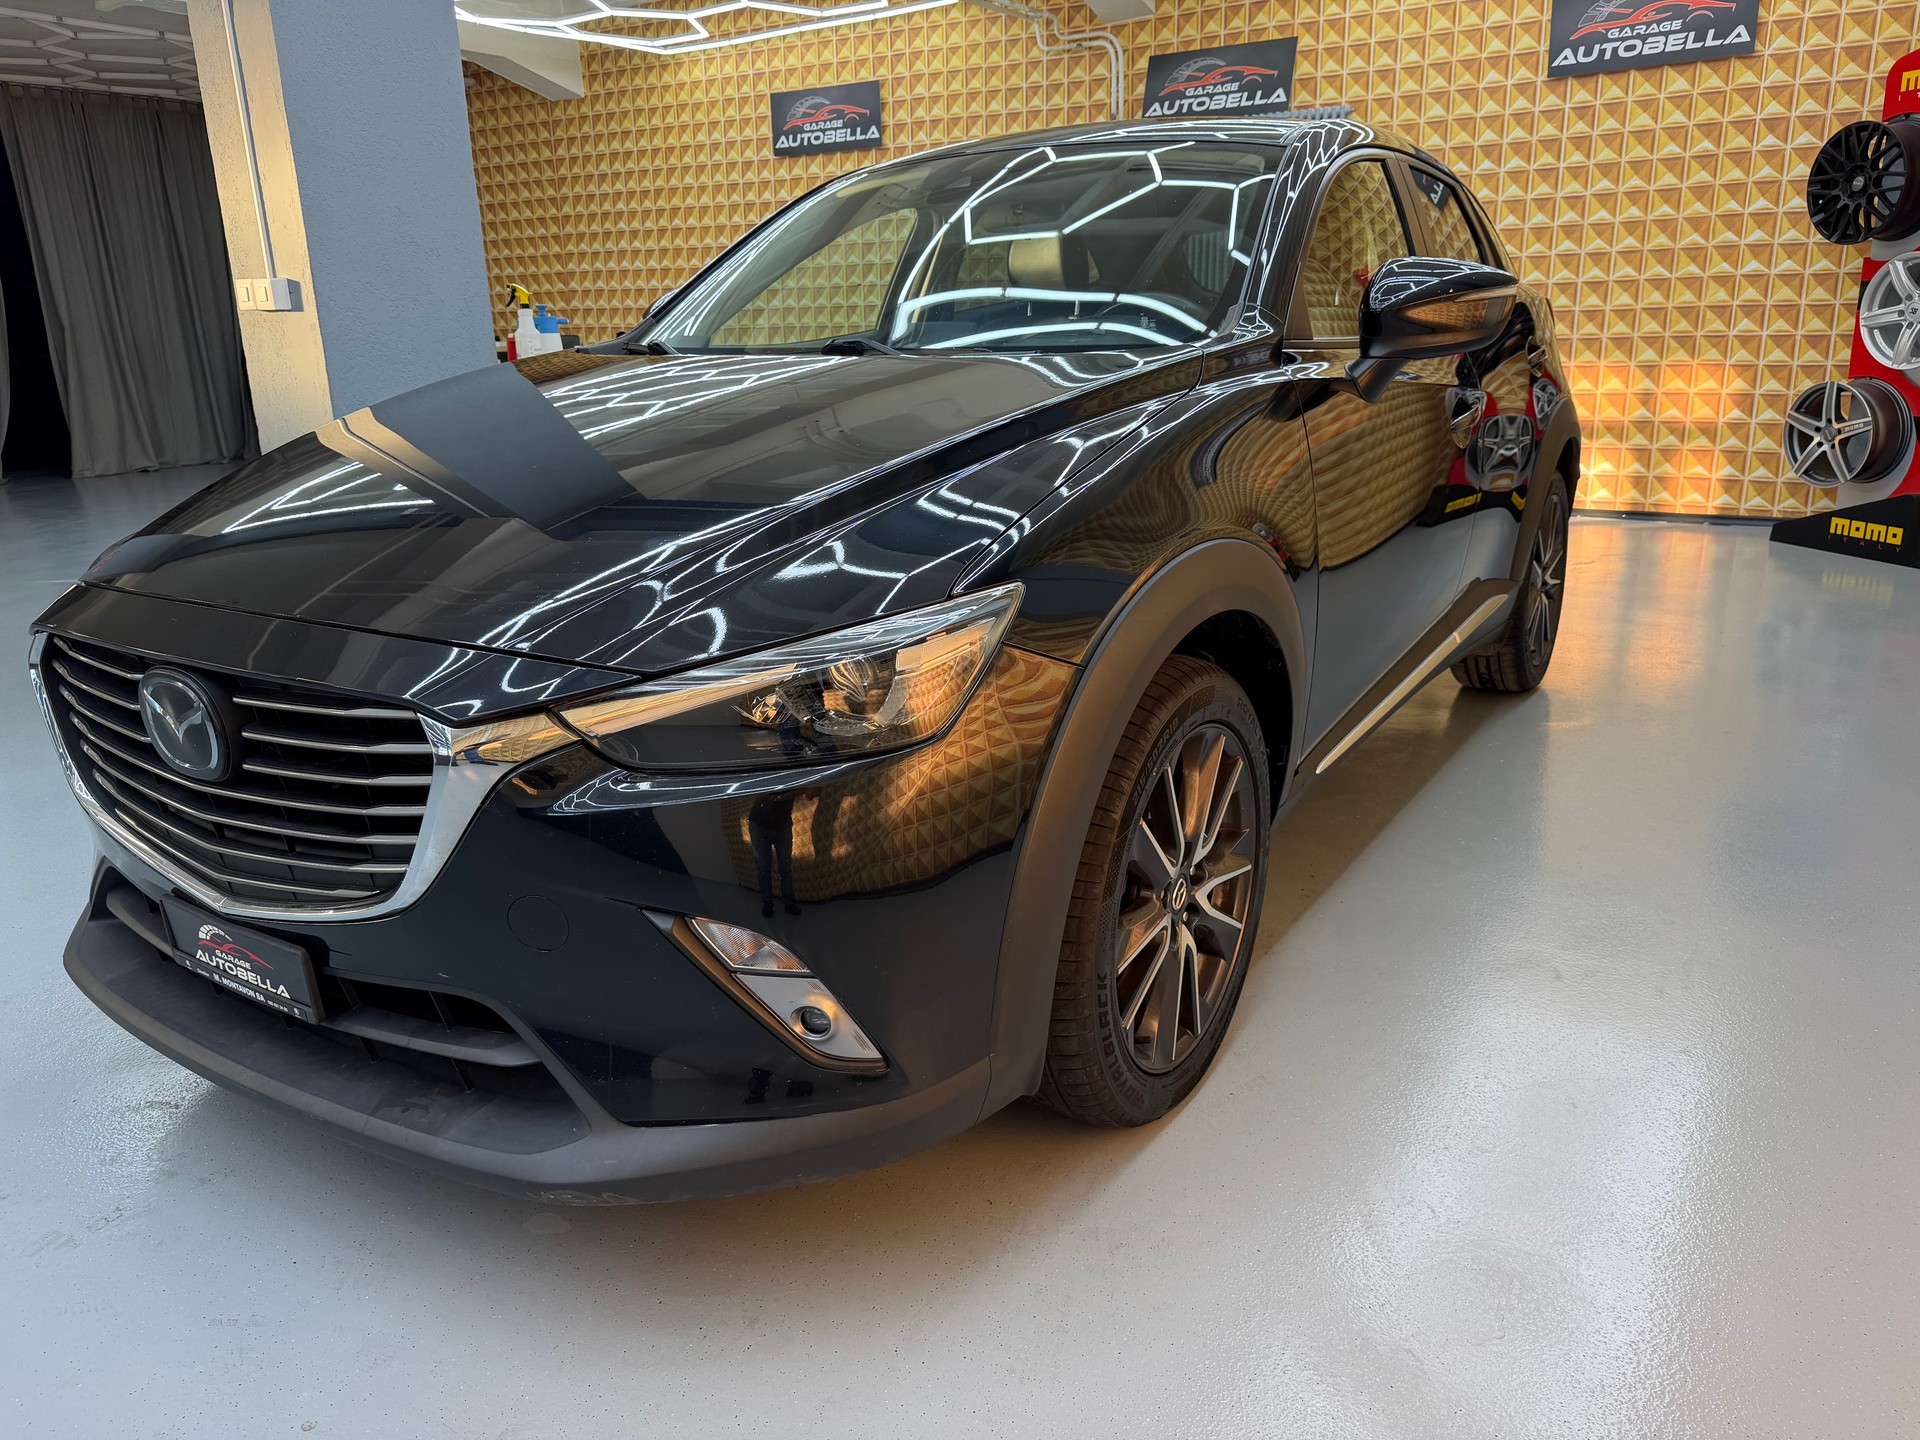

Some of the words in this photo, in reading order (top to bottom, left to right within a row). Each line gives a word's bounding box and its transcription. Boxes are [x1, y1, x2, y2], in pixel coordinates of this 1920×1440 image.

[1607, 19, 1683, 39] GARAGE
[1551, 24, 1751, 67] AUTOBELLA
[1185, 82, 1240, 97] GARAGE
[1144, 87, 1287, 117] AUTOBELLA
[803, 119, 844, 131] GARAGE
[775, 125, 880, 149] AUTOBELLA
[1828, 534, 1901, 553] ITALY
[215, 949, 252, 970] GARAGE
[196, 949, 291, 999] AUTOBELLA
